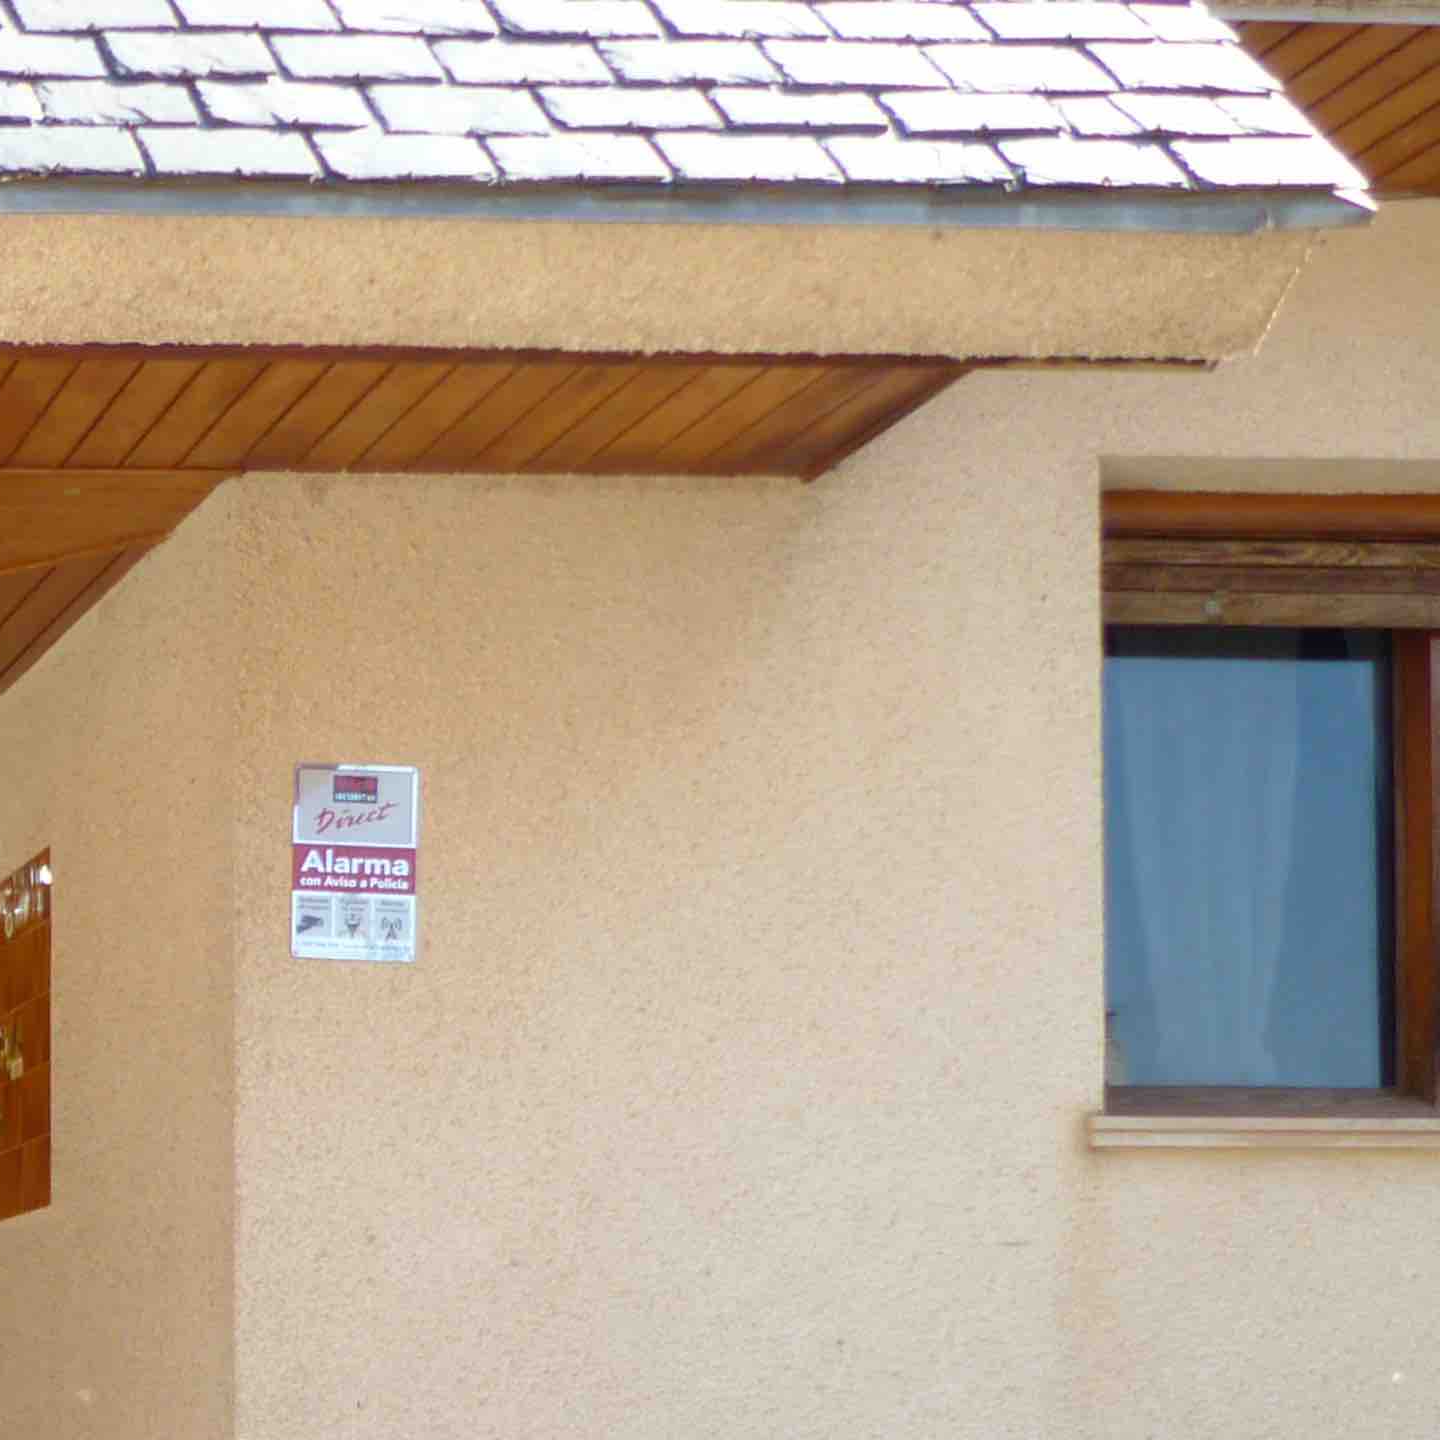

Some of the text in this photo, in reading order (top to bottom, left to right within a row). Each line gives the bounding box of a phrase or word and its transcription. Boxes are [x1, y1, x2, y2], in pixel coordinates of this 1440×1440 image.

[315, 801, 399, 834] Direct
[300, 848, 409, 876] Alarma
[299, 877, 321, 888] con
[323, 875, 357, 888] Aviso
[360, 879, 368, 888] a
